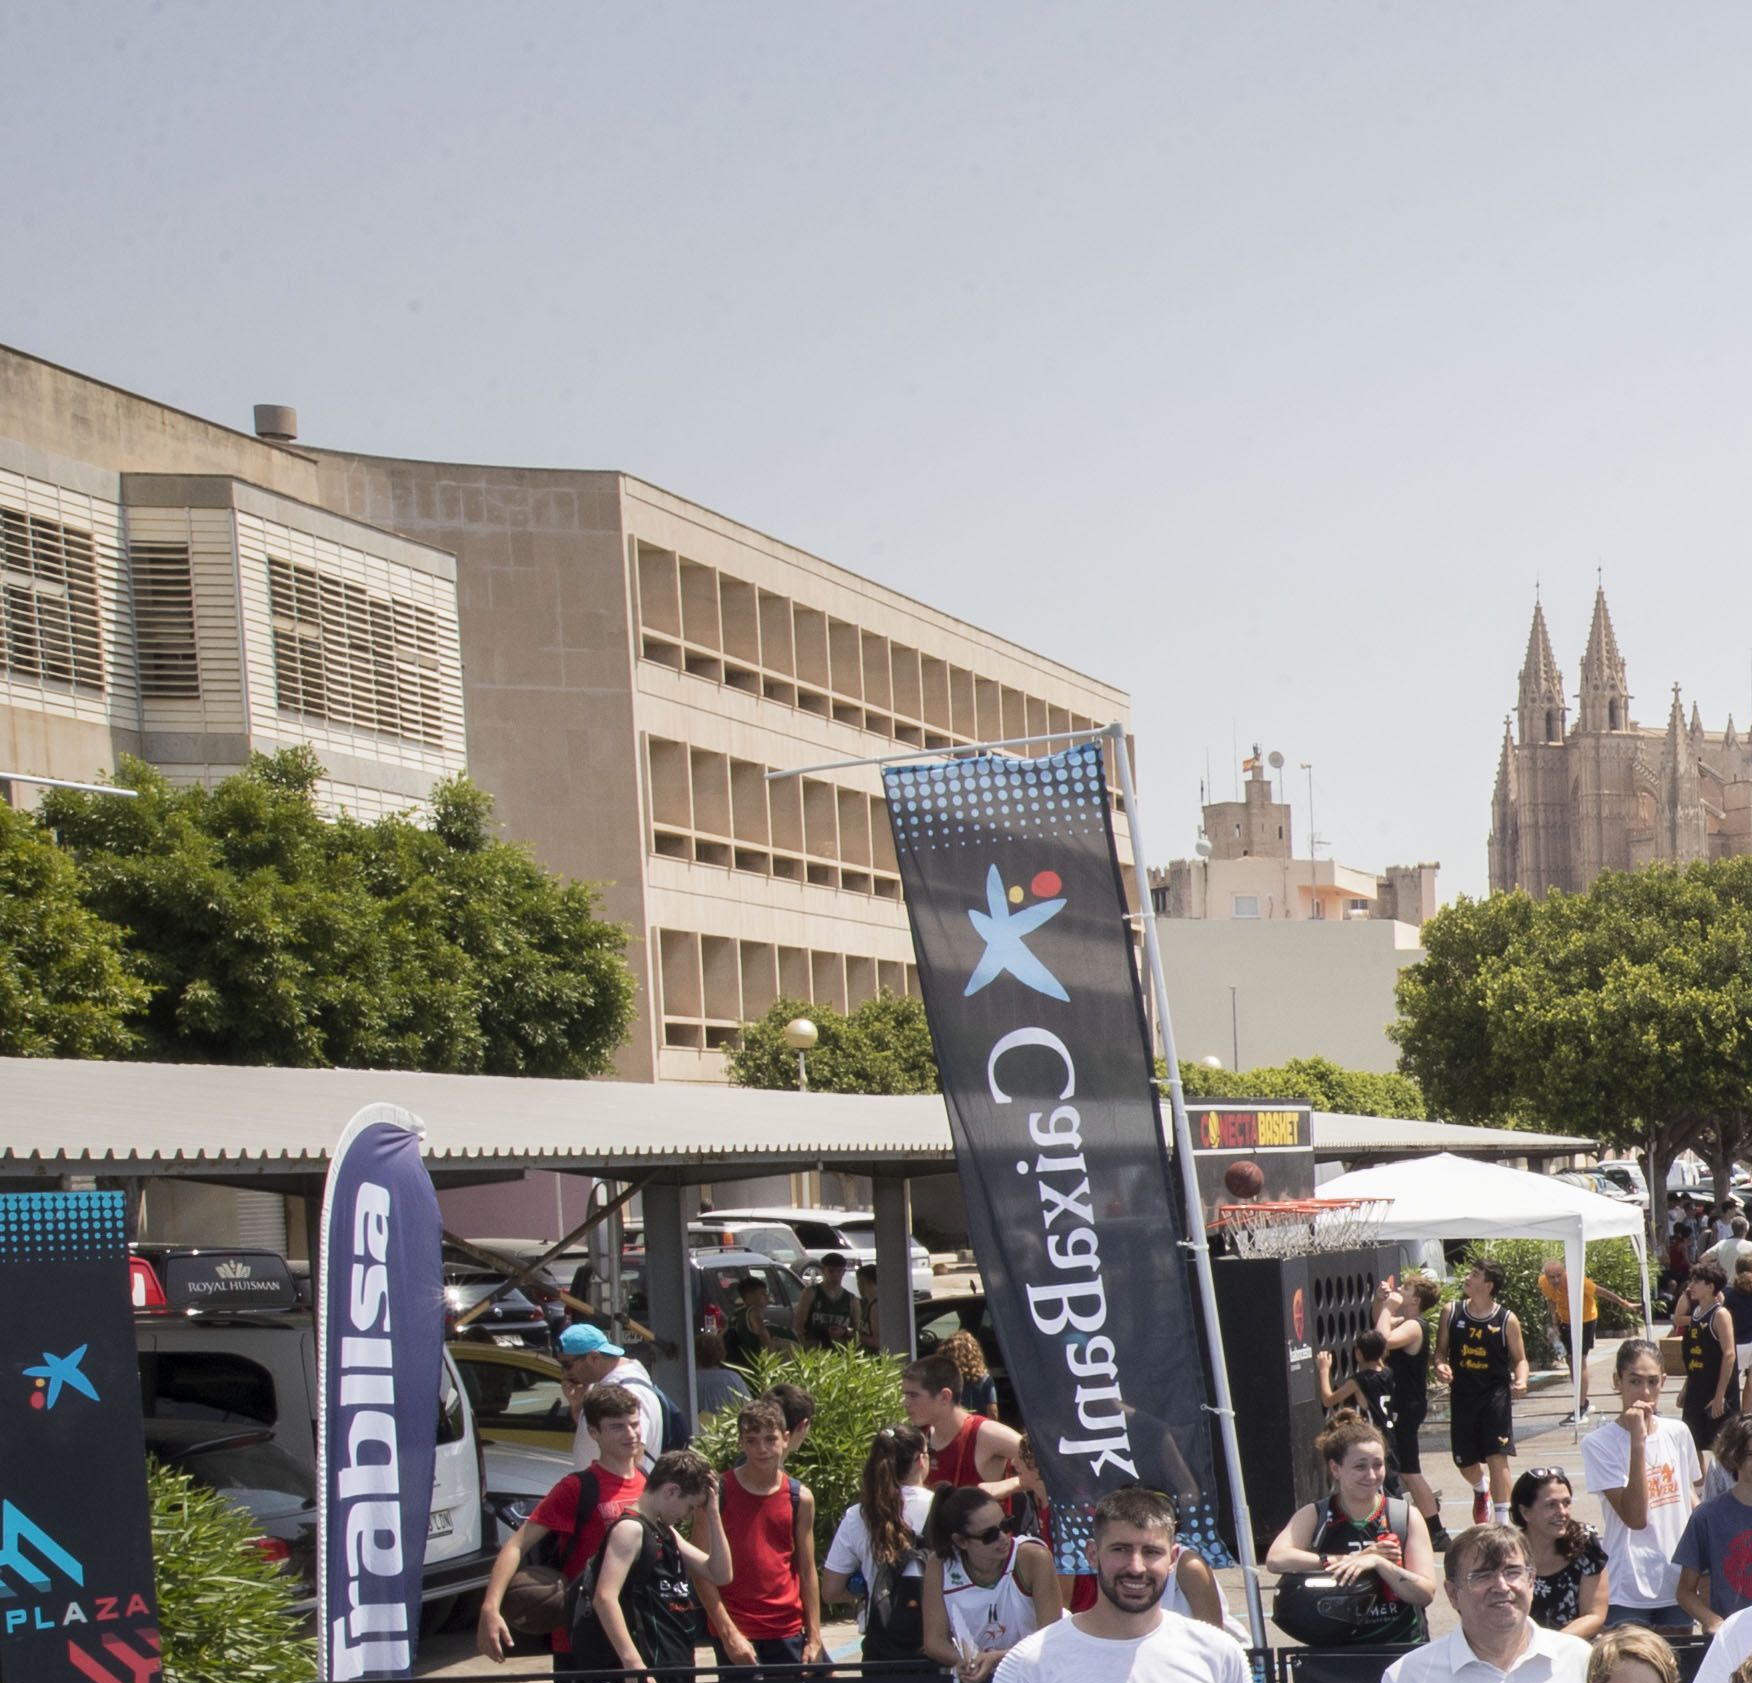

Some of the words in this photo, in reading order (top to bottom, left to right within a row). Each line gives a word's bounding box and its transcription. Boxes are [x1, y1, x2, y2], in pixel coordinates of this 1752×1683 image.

[187, 1281, 228, 1295] ROYAL
[229, 1280, 281, 1291] HUISMAN
[1468, 1327, 1484, 1339] 74
[6, 1593, 151, 1634] PLAZA
